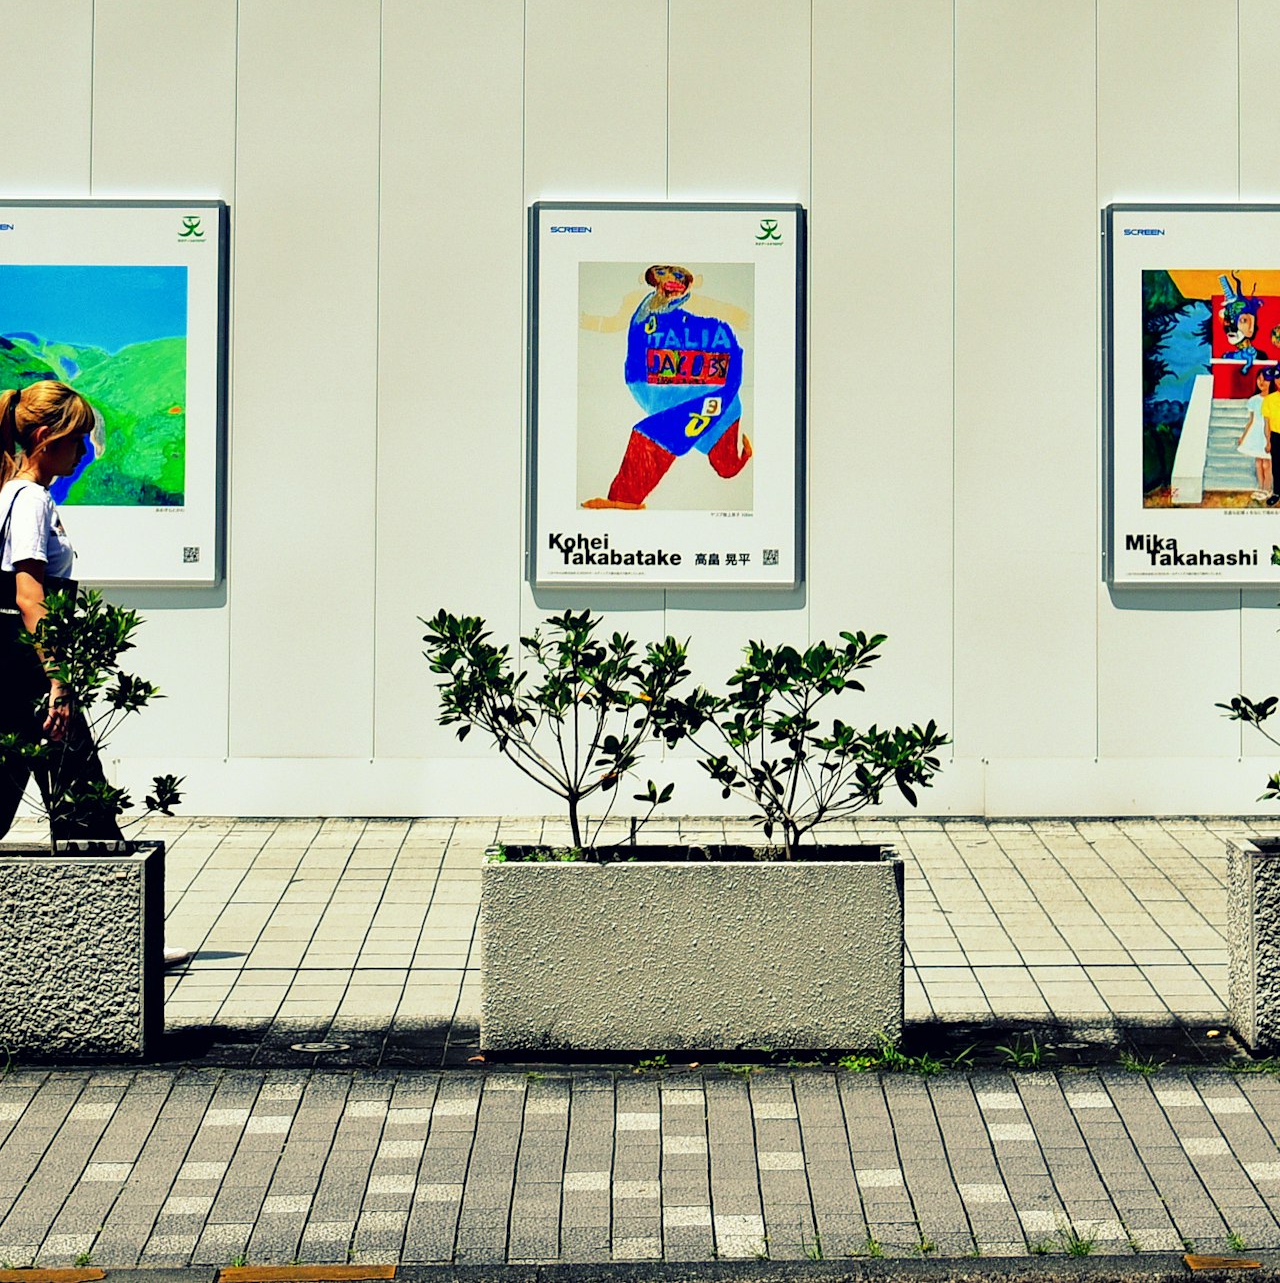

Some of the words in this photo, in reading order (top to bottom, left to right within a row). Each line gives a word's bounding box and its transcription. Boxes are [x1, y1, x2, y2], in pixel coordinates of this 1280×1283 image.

[549, 225, 592, 234] SCREEN
[647, 325, 731, 349] ITALIA
[548, 533, 609, 550] Kohei
[1125, 534, 1177, 551] Mika
[560, 549, 682, 566] Takabatake
[1147, 549, 1258, 566] Takahashi
